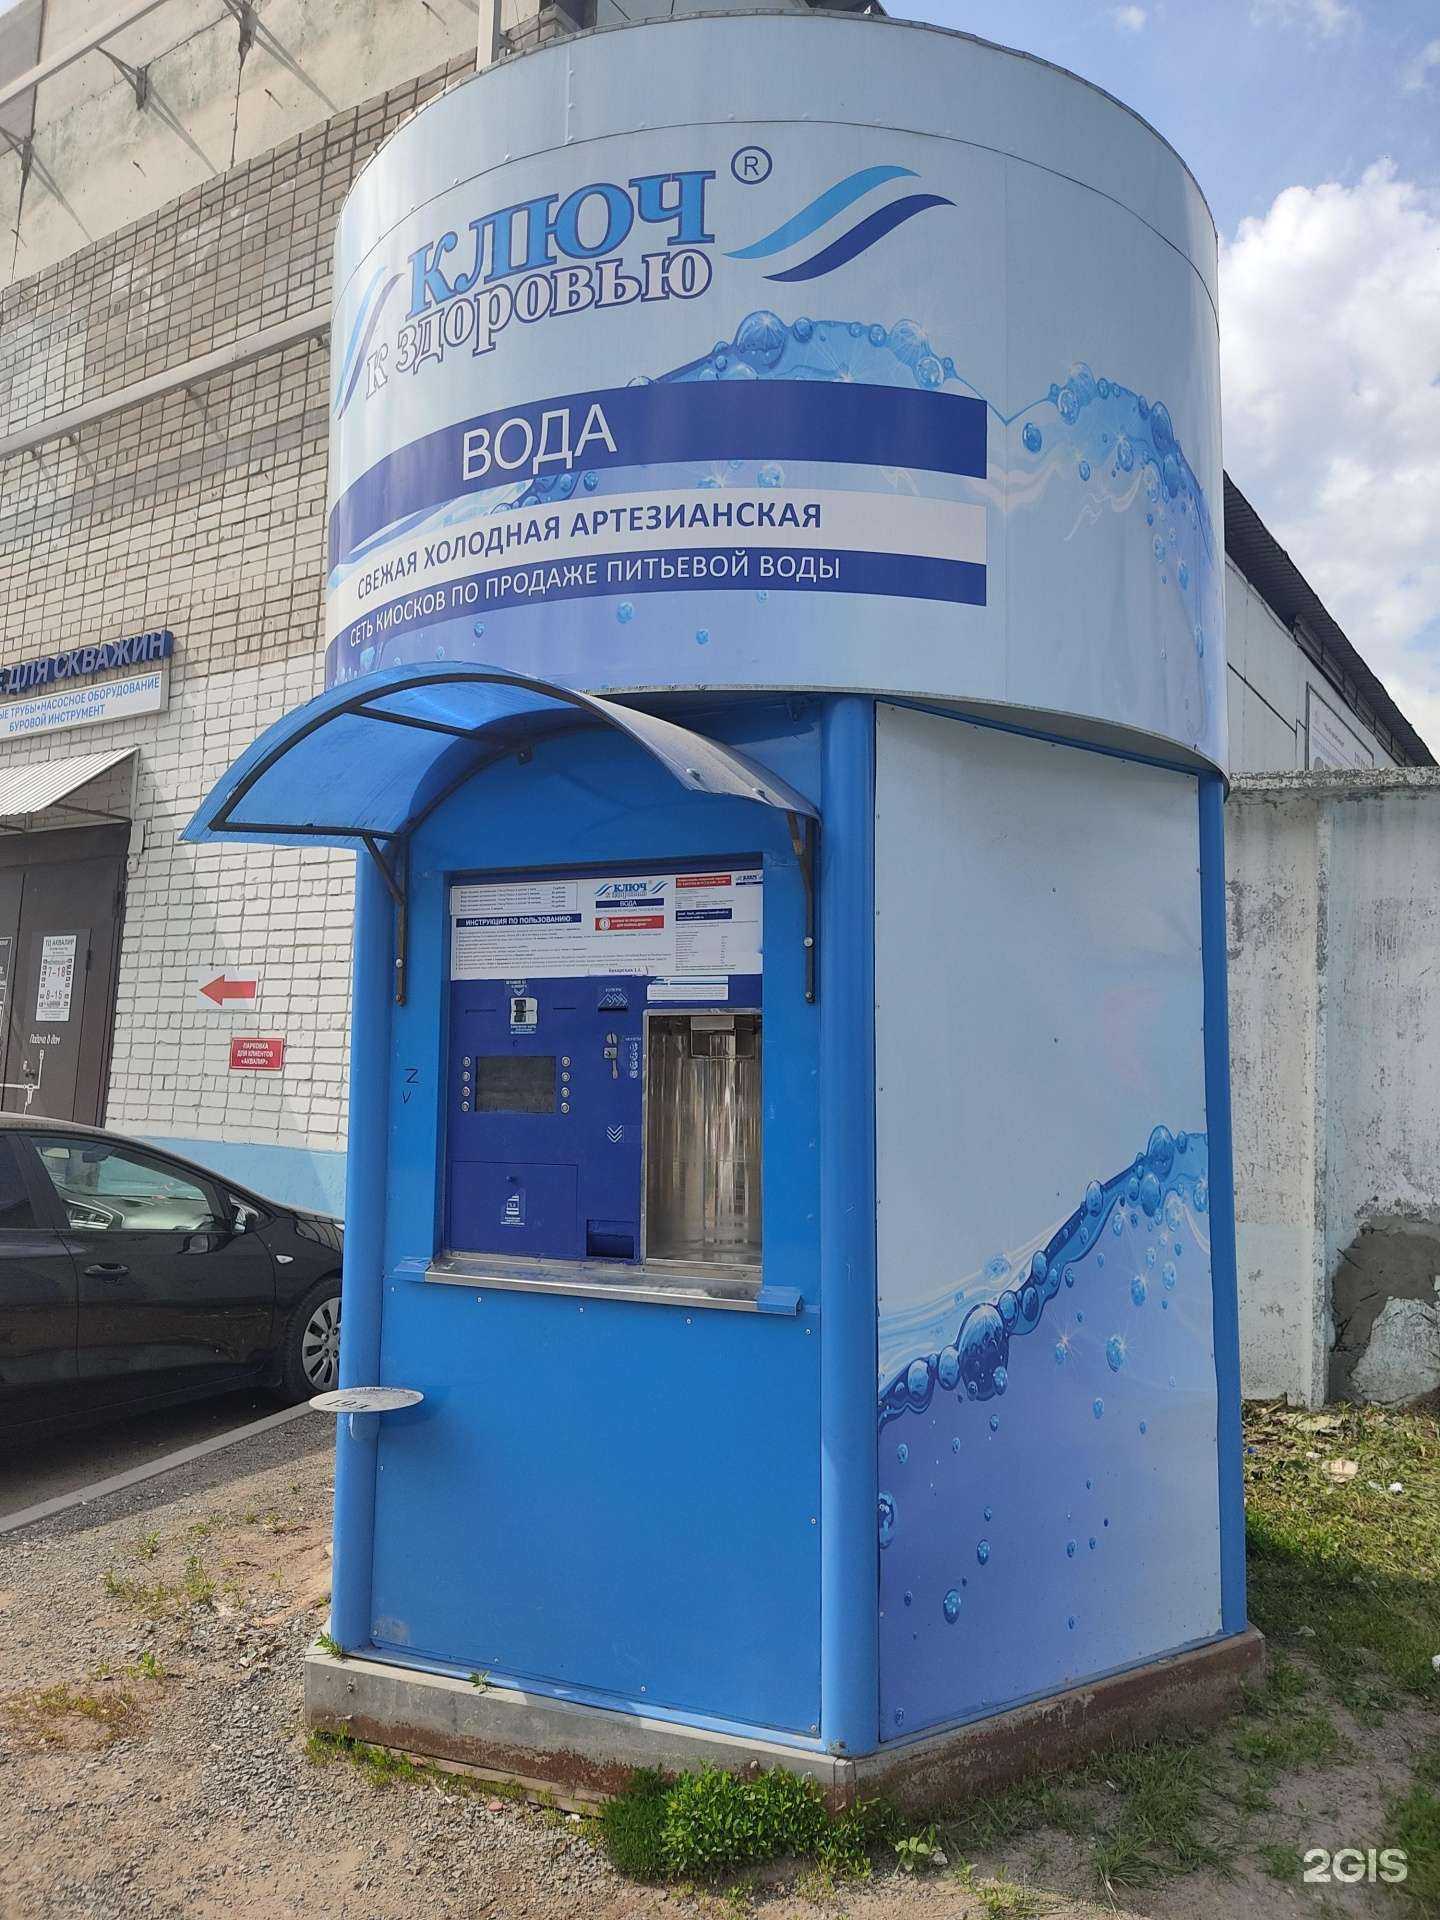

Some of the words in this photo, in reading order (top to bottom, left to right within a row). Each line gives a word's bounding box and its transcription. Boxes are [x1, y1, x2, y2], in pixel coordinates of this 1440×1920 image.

[460, 403, 618, 481] ВОДА
[356, 547, 418, 601] СВЕЖАЯ
[422, 515, 562, 574] ХОЛОДНАЯ
[570, 501, 823, 540] АРТЕЗИАНСКАЯ
[349, 613, 375, 648] СЕТЬ
[375, 590, 447, 635] КИОСКОВ
[450, 581, 481, 606] ПО
[485, 563, 599, 601] ПРОДАЖЕ
[606, 547, 749, 582] ПИТЬЕВОЙ
[759, 554, 841, 582] ВОДЫ
[6, 657, 50, 694] ДЛЯ
[53, 629, 169, 678] СКВАЖИН
[87, 675, 160, 703] ОБОРУДОВАНИЕ
[9, 712, 47, 732] БУРОВОЙ
[48, 703, 106, 725] ИНСТРУМЕНТ
[613, 881, 648, 893] КЛЮЧ
[465, 917, 508, 927] ИНСТРУКЦИЯ
[508, 917, 519, 925] ПО
[242, 1042, 269, 1050] ПАРКОВКА
[248, 1050, 274, 1058] КЛИЕНТОВ
